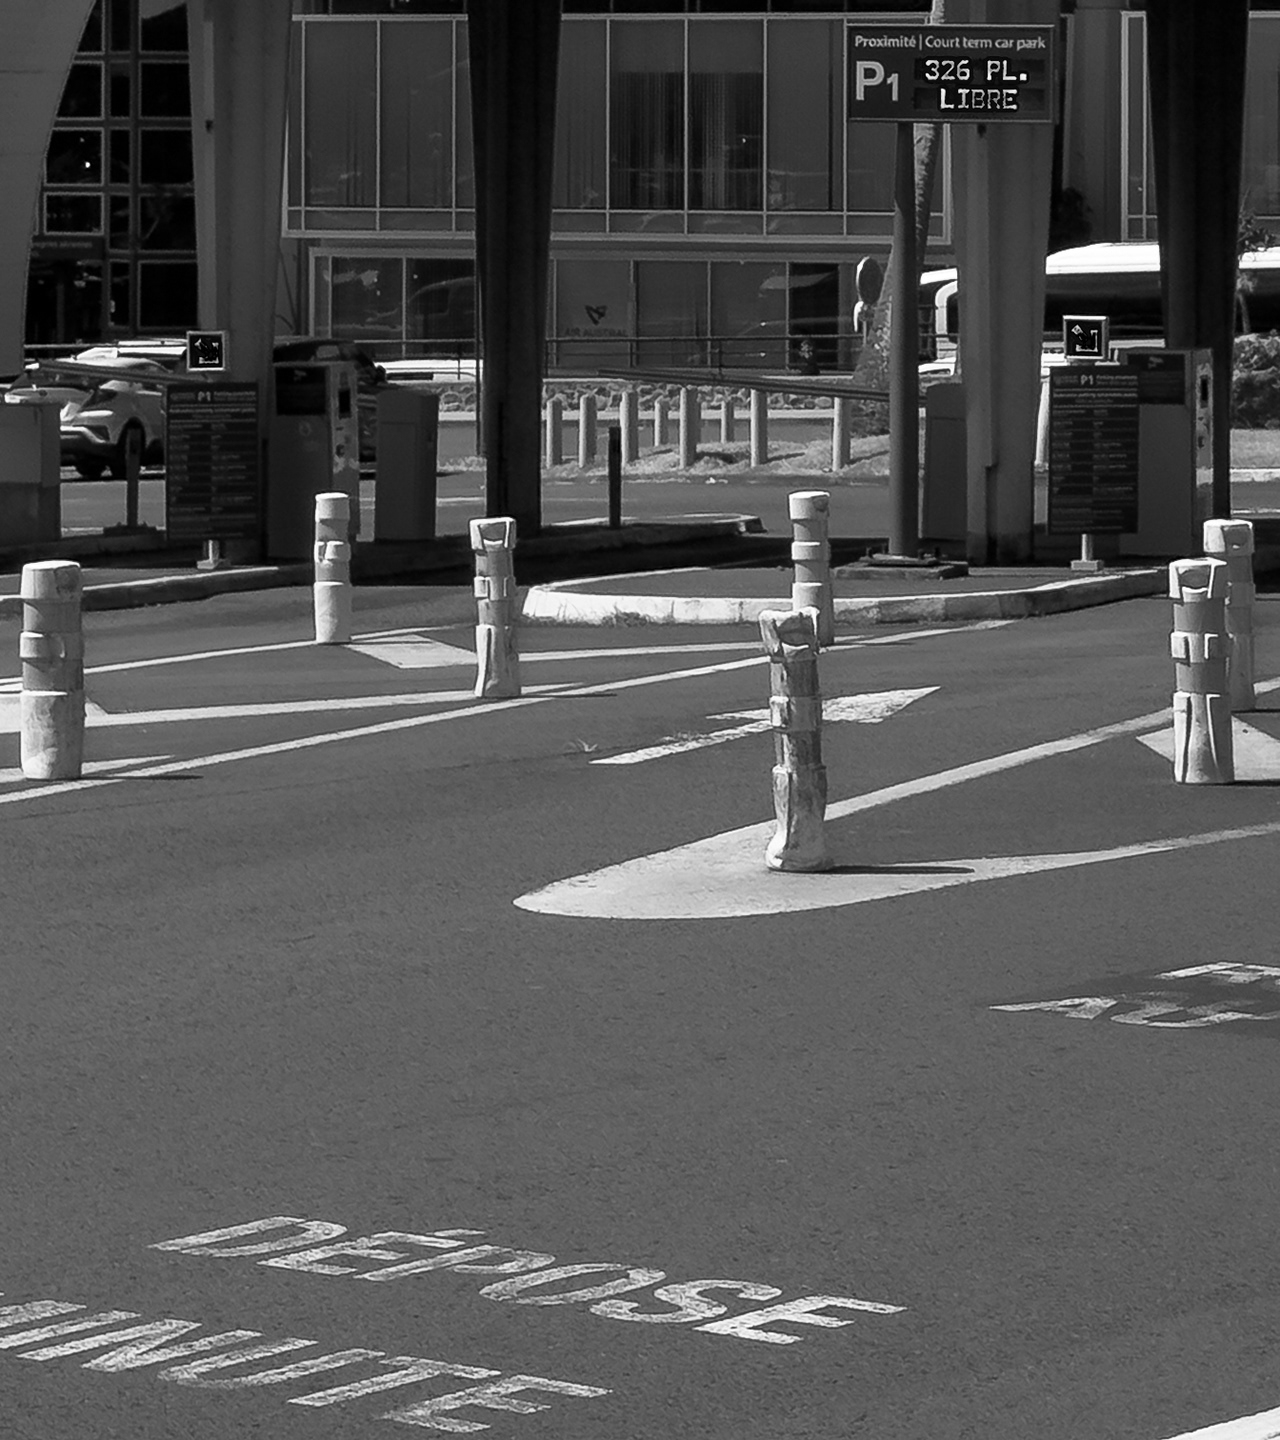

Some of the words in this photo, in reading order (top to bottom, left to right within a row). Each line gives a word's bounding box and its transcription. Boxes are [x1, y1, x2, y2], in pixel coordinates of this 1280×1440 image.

[854, 34, 917, 49] Proximité
[925, 35, 960, 49] Court
[962, 36, 992, 49] term
[995, 39, 1015, 49] car
[1016, 35, 1046, 51] park
[855, 60, 899, 101] P1
[925, 59, 971, 81] 326
[986, 59, 1028, 81] PL.
[940, 87, 1018, 110] LIBRE
[144, 1215, 909, 1347] DÉPOSE
